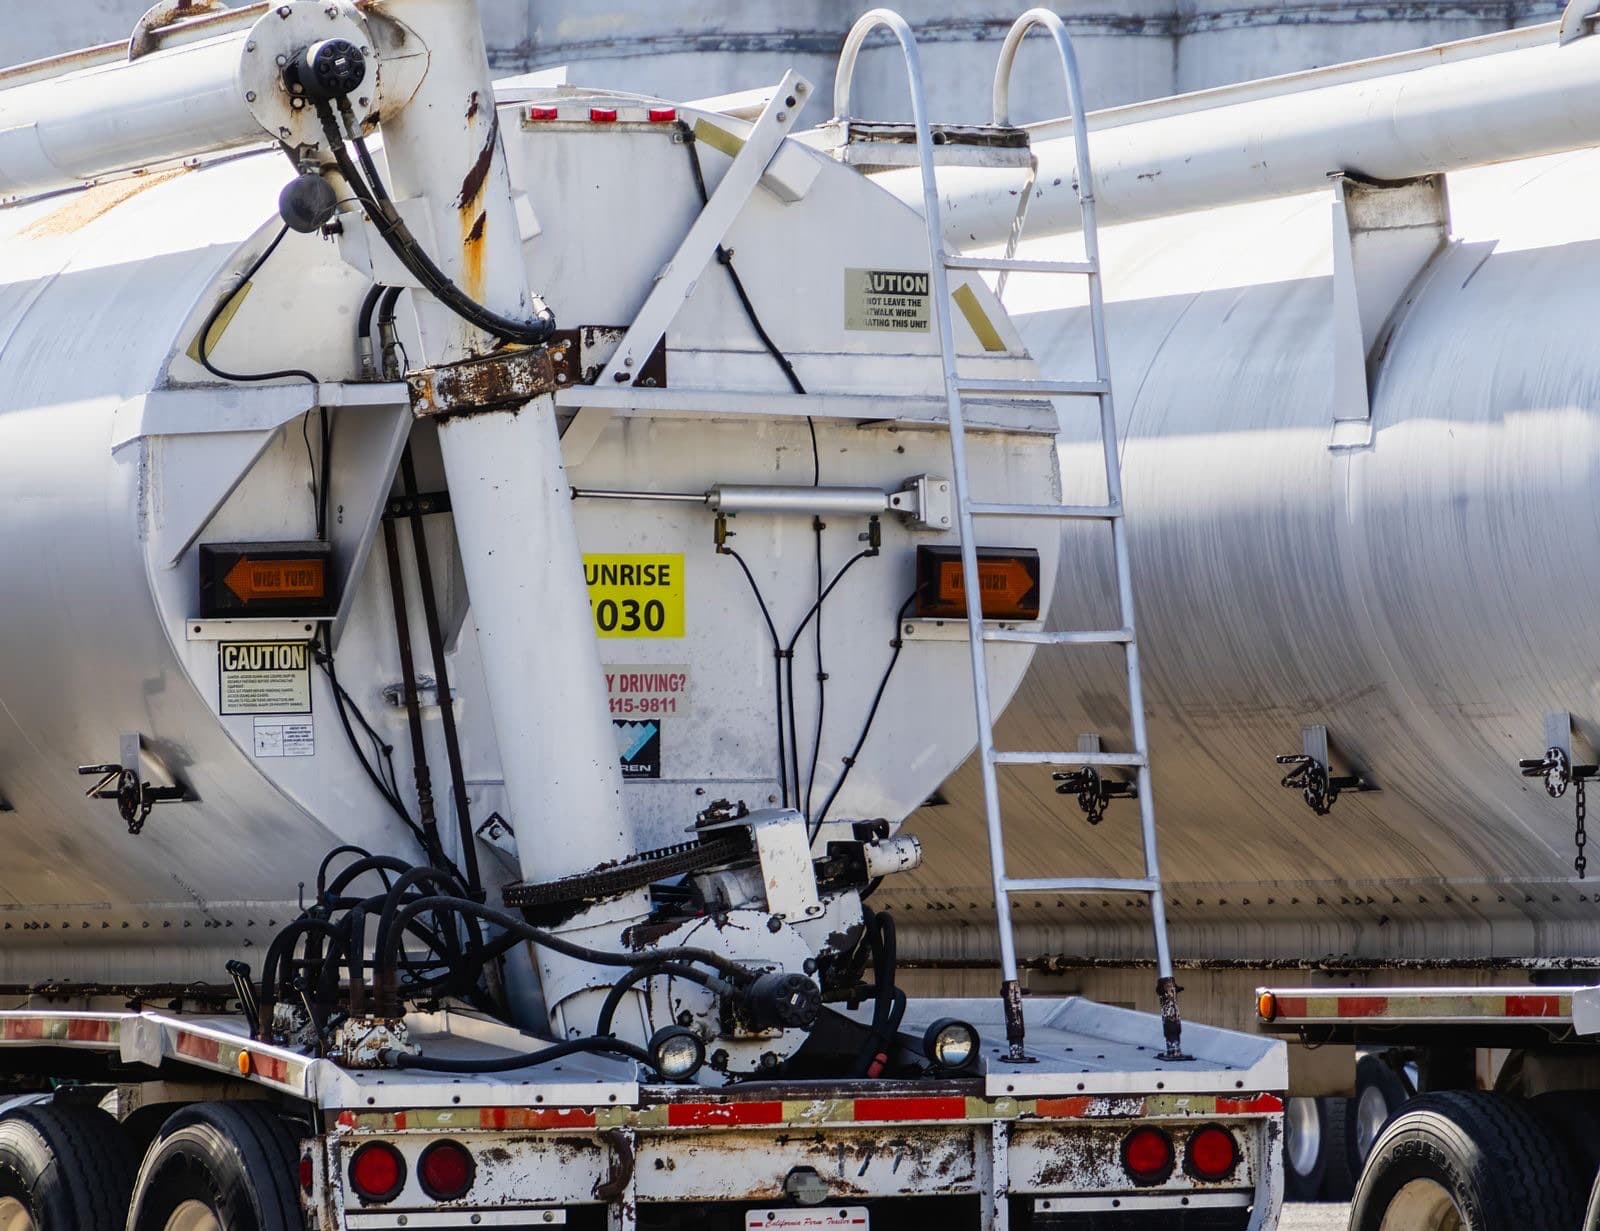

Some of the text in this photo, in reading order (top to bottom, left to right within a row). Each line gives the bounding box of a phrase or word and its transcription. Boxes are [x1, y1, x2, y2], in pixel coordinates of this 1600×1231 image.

[865, 274, 927, 293] AUTION
[883, 298, 906, 306] LEAVE
[907, 298, 922, 307] THE
[895, 308, 917, 317] WHEN
[865, 318, 927, 329] ATING THIS UNIT
[583, 564, 671, 586] UNRISE
[590, 599, 665, 631] 030
[224, 645, 306, 671] CAUTION
[605, 673, 687, 693] Y DRIVING?
[620, 764, 652, 772] REN
